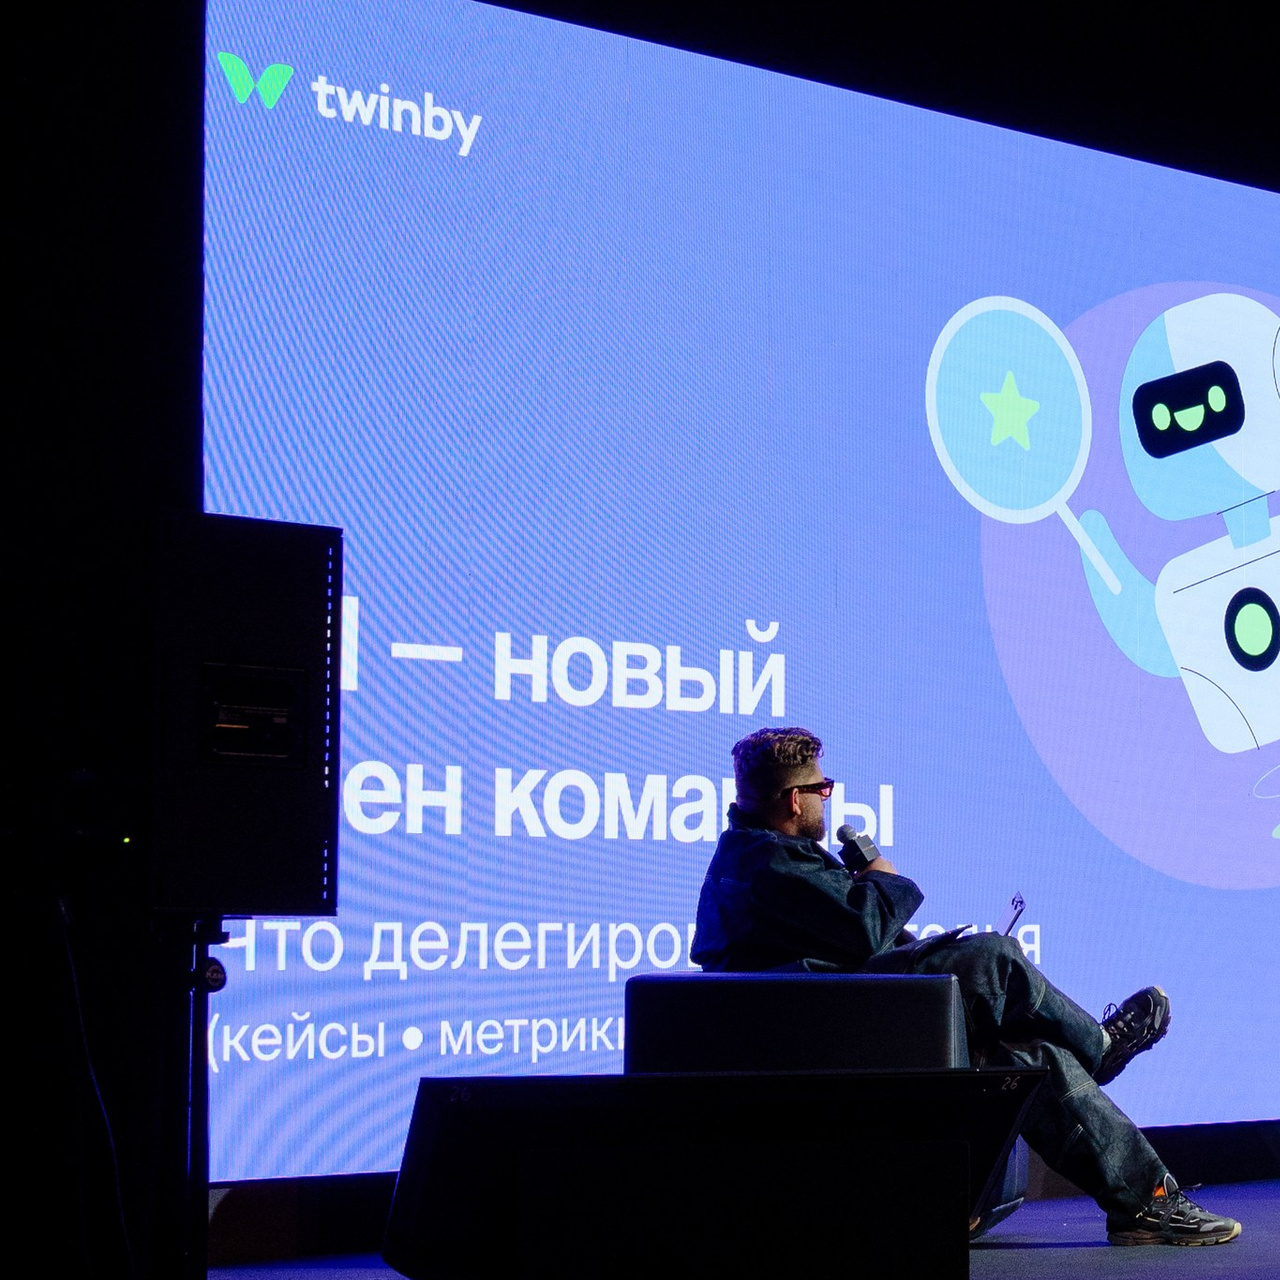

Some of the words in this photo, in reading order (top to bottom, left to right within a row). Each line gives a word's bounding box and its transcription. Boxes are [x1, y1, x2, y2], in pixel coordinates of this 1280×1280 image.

[311, 75, 483, 157] twinby
[494, 619, 786, 718] новый
[342, 760, 463, 836] ен
[494, 765, 894, 850] комаы
[363, 921, 702, 983] делегиро
[208, 1011, 386, 1074] (кейсы
